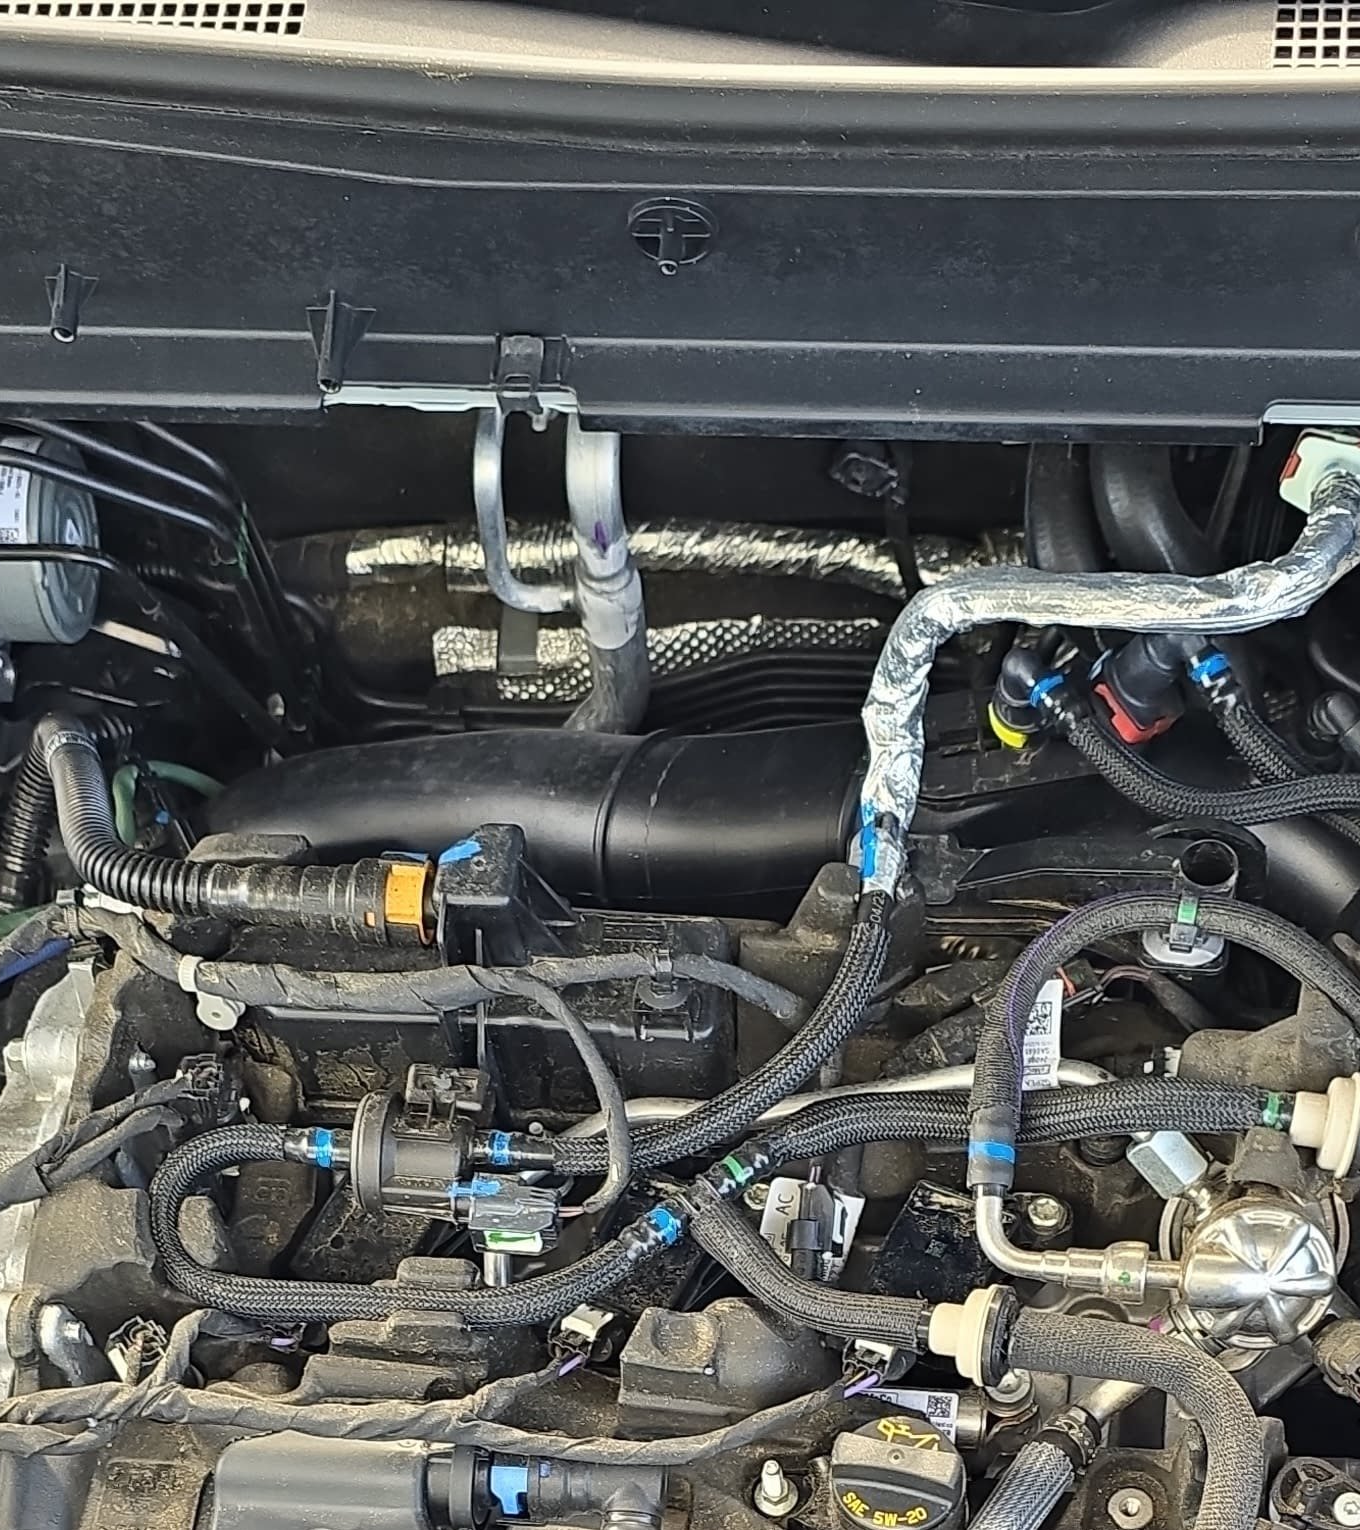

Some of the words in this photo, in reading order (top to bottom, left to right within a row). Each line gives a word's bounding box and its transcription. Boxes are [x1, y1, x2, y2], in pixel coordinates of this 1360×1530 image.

[775, 1193, 794, 1216] AC
[843, 1492, 869, 1517] SAE
[873, 1507, 927, 1526] 5W-20
